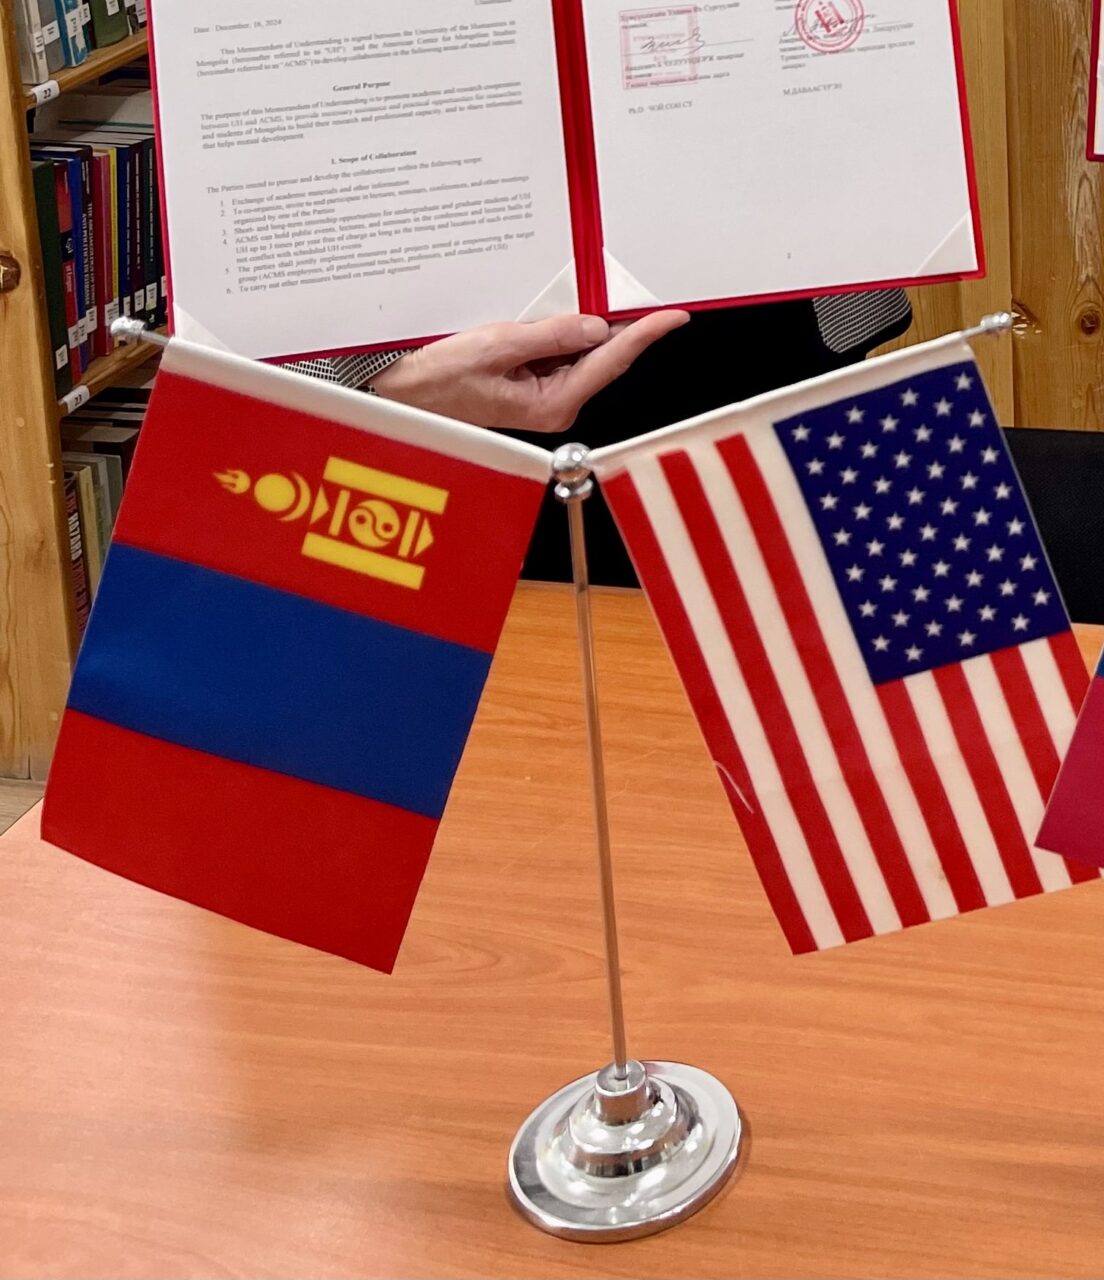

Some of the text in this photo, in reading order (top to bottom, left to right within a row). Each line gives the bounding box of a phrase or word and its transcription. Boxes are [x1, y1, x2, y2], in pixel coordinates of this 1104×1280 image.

[362, 81, 390, 89] Purpose
[338, 156, 358, 164] Scope
[369, 150, 416, 159] Collaboration
